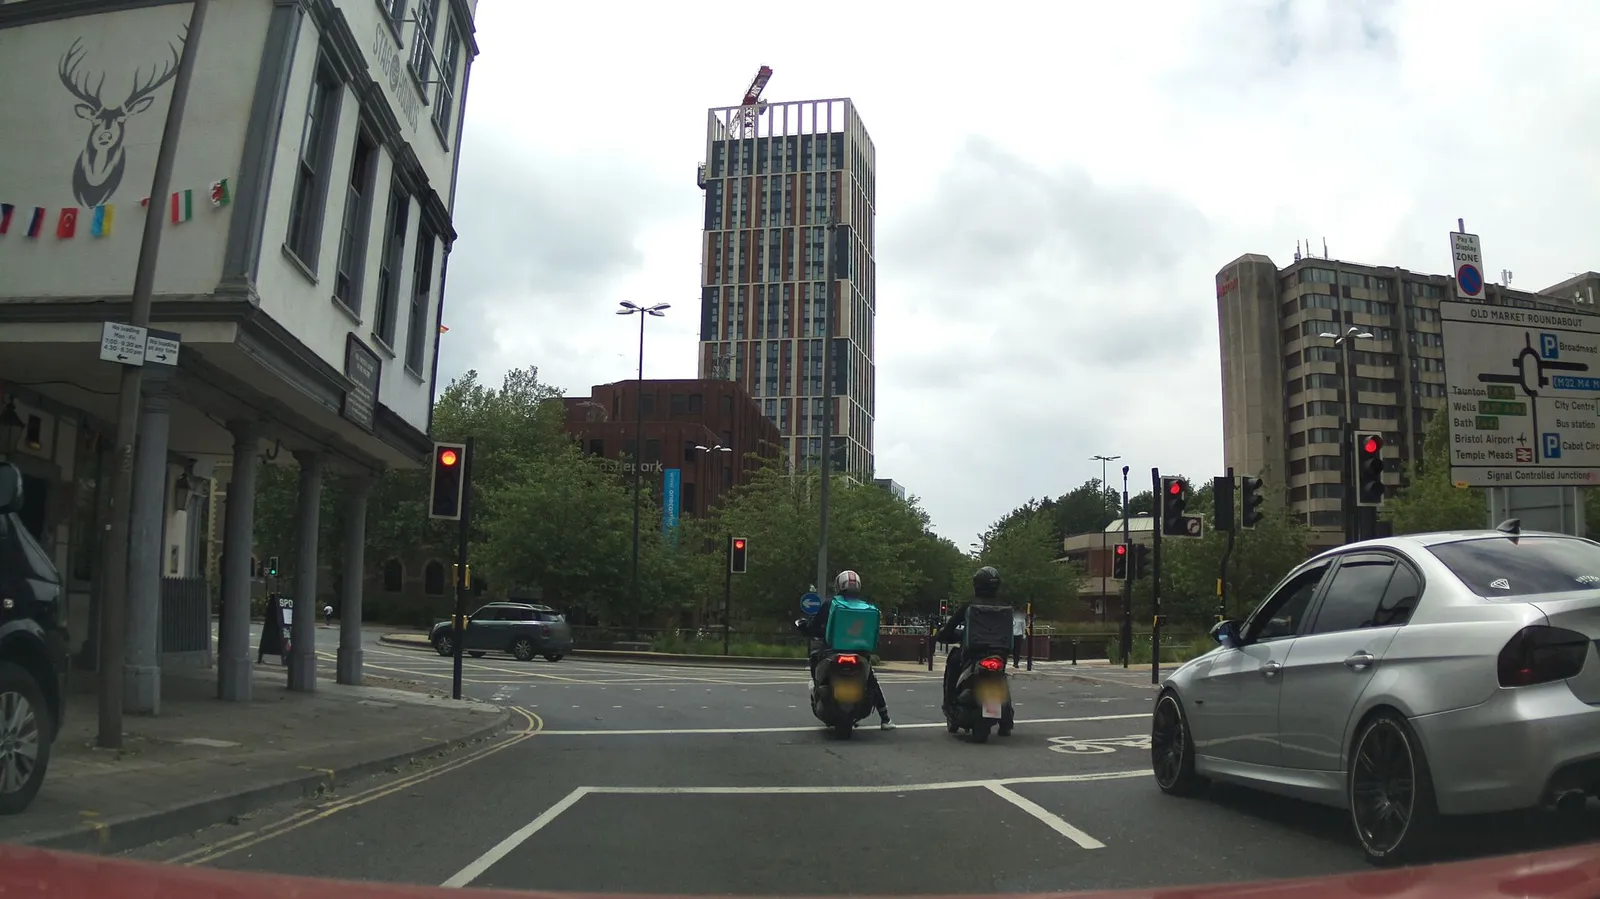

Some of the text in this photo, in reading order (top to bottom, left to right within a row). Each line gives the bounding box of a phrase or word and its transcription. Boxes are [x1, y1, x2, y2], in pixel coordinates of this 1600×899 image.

[373, 22, 392, 76] STAG
[1456, 244, 1476, 252] Display
[1456, 252, 1479, 262] ZONE
[1470, 309, 1582, 328] OLD MARKET ROUNDABOUT
[1559, 342, 1597, 354] Broadmead
[1452, 386, 1486, 396] Taunton
[1453, 402, 1476, 412] Wells
[1555, 401, 1595, 411] City Centre
[1454, 418, 1474, 428] Bath
[1556, 419, 1596, 428] Bus station
[1455, 434, 1514, 445] Bristol Airport
[1562, 442, 1584, 450] Cabot
[1455, 450, 1514, 460] Temple Meads
[1487, 471, 1590, 481] Signal Controlled Junctions
